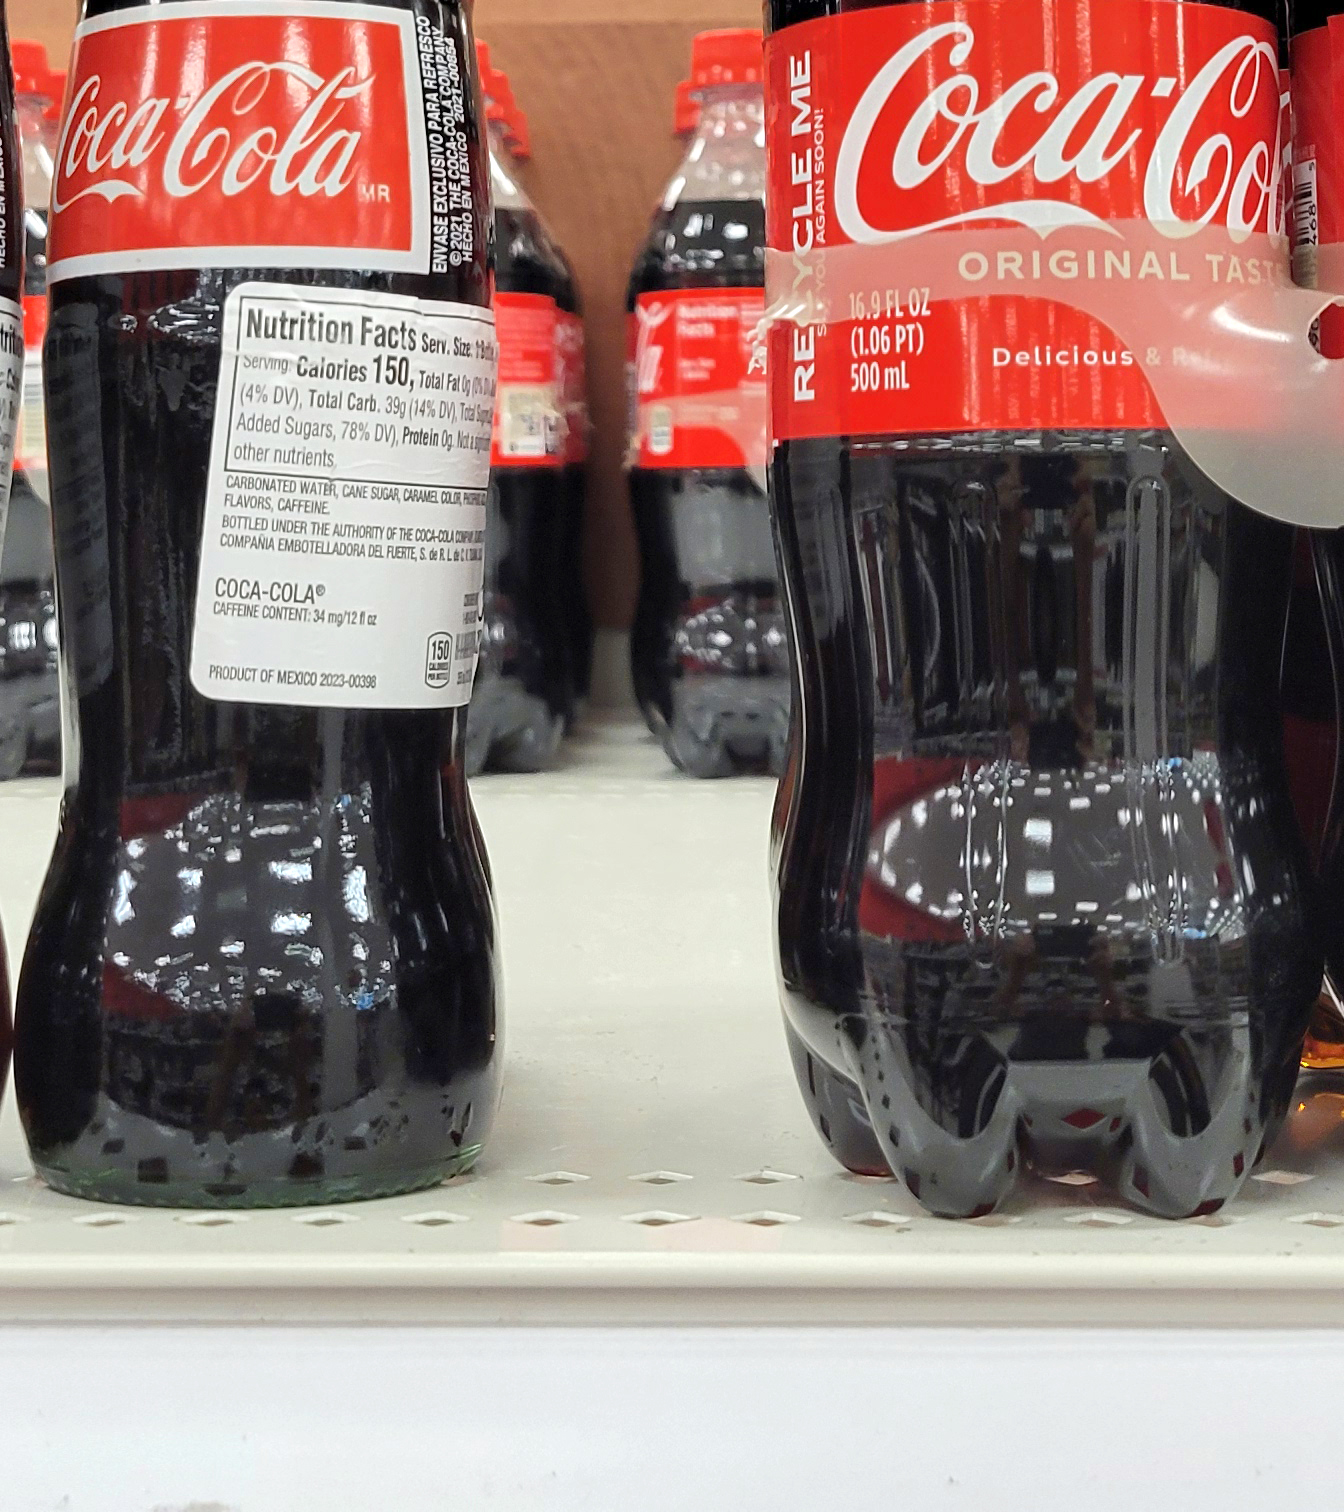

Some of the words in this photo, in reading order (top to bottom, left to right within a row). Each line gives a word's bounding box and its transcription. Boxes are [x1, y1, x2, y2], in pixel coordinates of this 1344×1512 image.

[416, 16, 438, 90] REFRESCO
[432, 26, 452, 96] COMPANY
[444, 37, 465, 123] 2021-00854
[790, 50, 812, 136] ME
[425, 92, 443, 131] PARA
[53, 60, 377, 215] Coca-Cola
[441, 100, 460, 180] COCA-COLA
[814, 108, 825, 174] SOON!
[834, 21, 1284, 245] Coca-Col
[429, 133, 448, 214] EXCLUSIVO
[456, 131, 471, 187] MEXICO
[448, 181, 462, 210] THE
[461, 190, 473, 209] EN
[815, 179, 826, 244] AGAIN
[432, 215, 448, 274] ENVASE
[462, 212, 474, 262] HECHO
[958, 250, 1190, 281] ORIGINAL
[849, 289, 881, 321] 16.9
[886, 288, 904, 318] FL
[908, 287, 932, 317] OZ
[246, 308, 354, 345] Nutrition
[360, 315, 417, 352] Facts
[421, 332, 450, 356] Serv.
[851, 324, 891, 358] (1.06
[895, 322, 924, 356] PT)
[296, 355, 368, 383] Calories
[372, 353, 415, 393] 150,
[419, 369, 444, 391] Total
[446, 373, 460, 393] Fat
[850, 361, 881, 392] 500
[884, 359, 910, 390] mL
[992, 345, 1134, 367] Delicious
[240, 382, 268, 406] (4%
[273, 385, 303, 411] DV),
[308, 389, 343, 410] Total
[347, 392, 381, 414] Carb.
[385, 395, 407, 419] 39g
[409, 397, 436, 421] (14%
[236, 411, 281, 434] Added
[284, 415, 337, 442] Sugars,
[341, 420, 371, 442] 78%
[374, 422, 399, 448] DV),
[402, 425, 439, 448] Protein
[233, 441, 270, 463] other
[224, 493, 274, 513] FLAVORS,
[226, 474, 296, 493] CARBONATED
[300, 480, 339, 499] WATER,
[342, 483, 369, 499] CANE
[370, 486, 401, 504] SUGAR,
[403, 487, 439, 504] CARAMEL
[222, 514, 268, 531] BOTTLED
[271, 518, 307, 535] UNDER
[310, 521, 331, 537] THE
[332, 522, 385, 540] AUTHORITY
[386, 526, 397, 541] OF
[399, 527, 413, 542] THE
[415, 528, 454, 543] COCA-COLA
[277, 537, 366, 557] EMBOTELLADORA
[368, 544, 384, 559] DEL
[386, 545, 417, 562] FUERTE,
[419, 546, 426, 561] S.
[429, 547, 437, 561] de
[213, 600, 260, 619] CAFFEINE
[262, 605, 312, 623] CONTENT:
[313, 609, 325, 623] 34
[328, 609, 357, 628] mg/12
[367, 613, 378, 627] oz
[432, 639, 450, 661] 150
[209, 664, 258, 683] PRODUCT
[260, 668, 274, 683] OF
[276, 669, 318, 687] MEXICO
